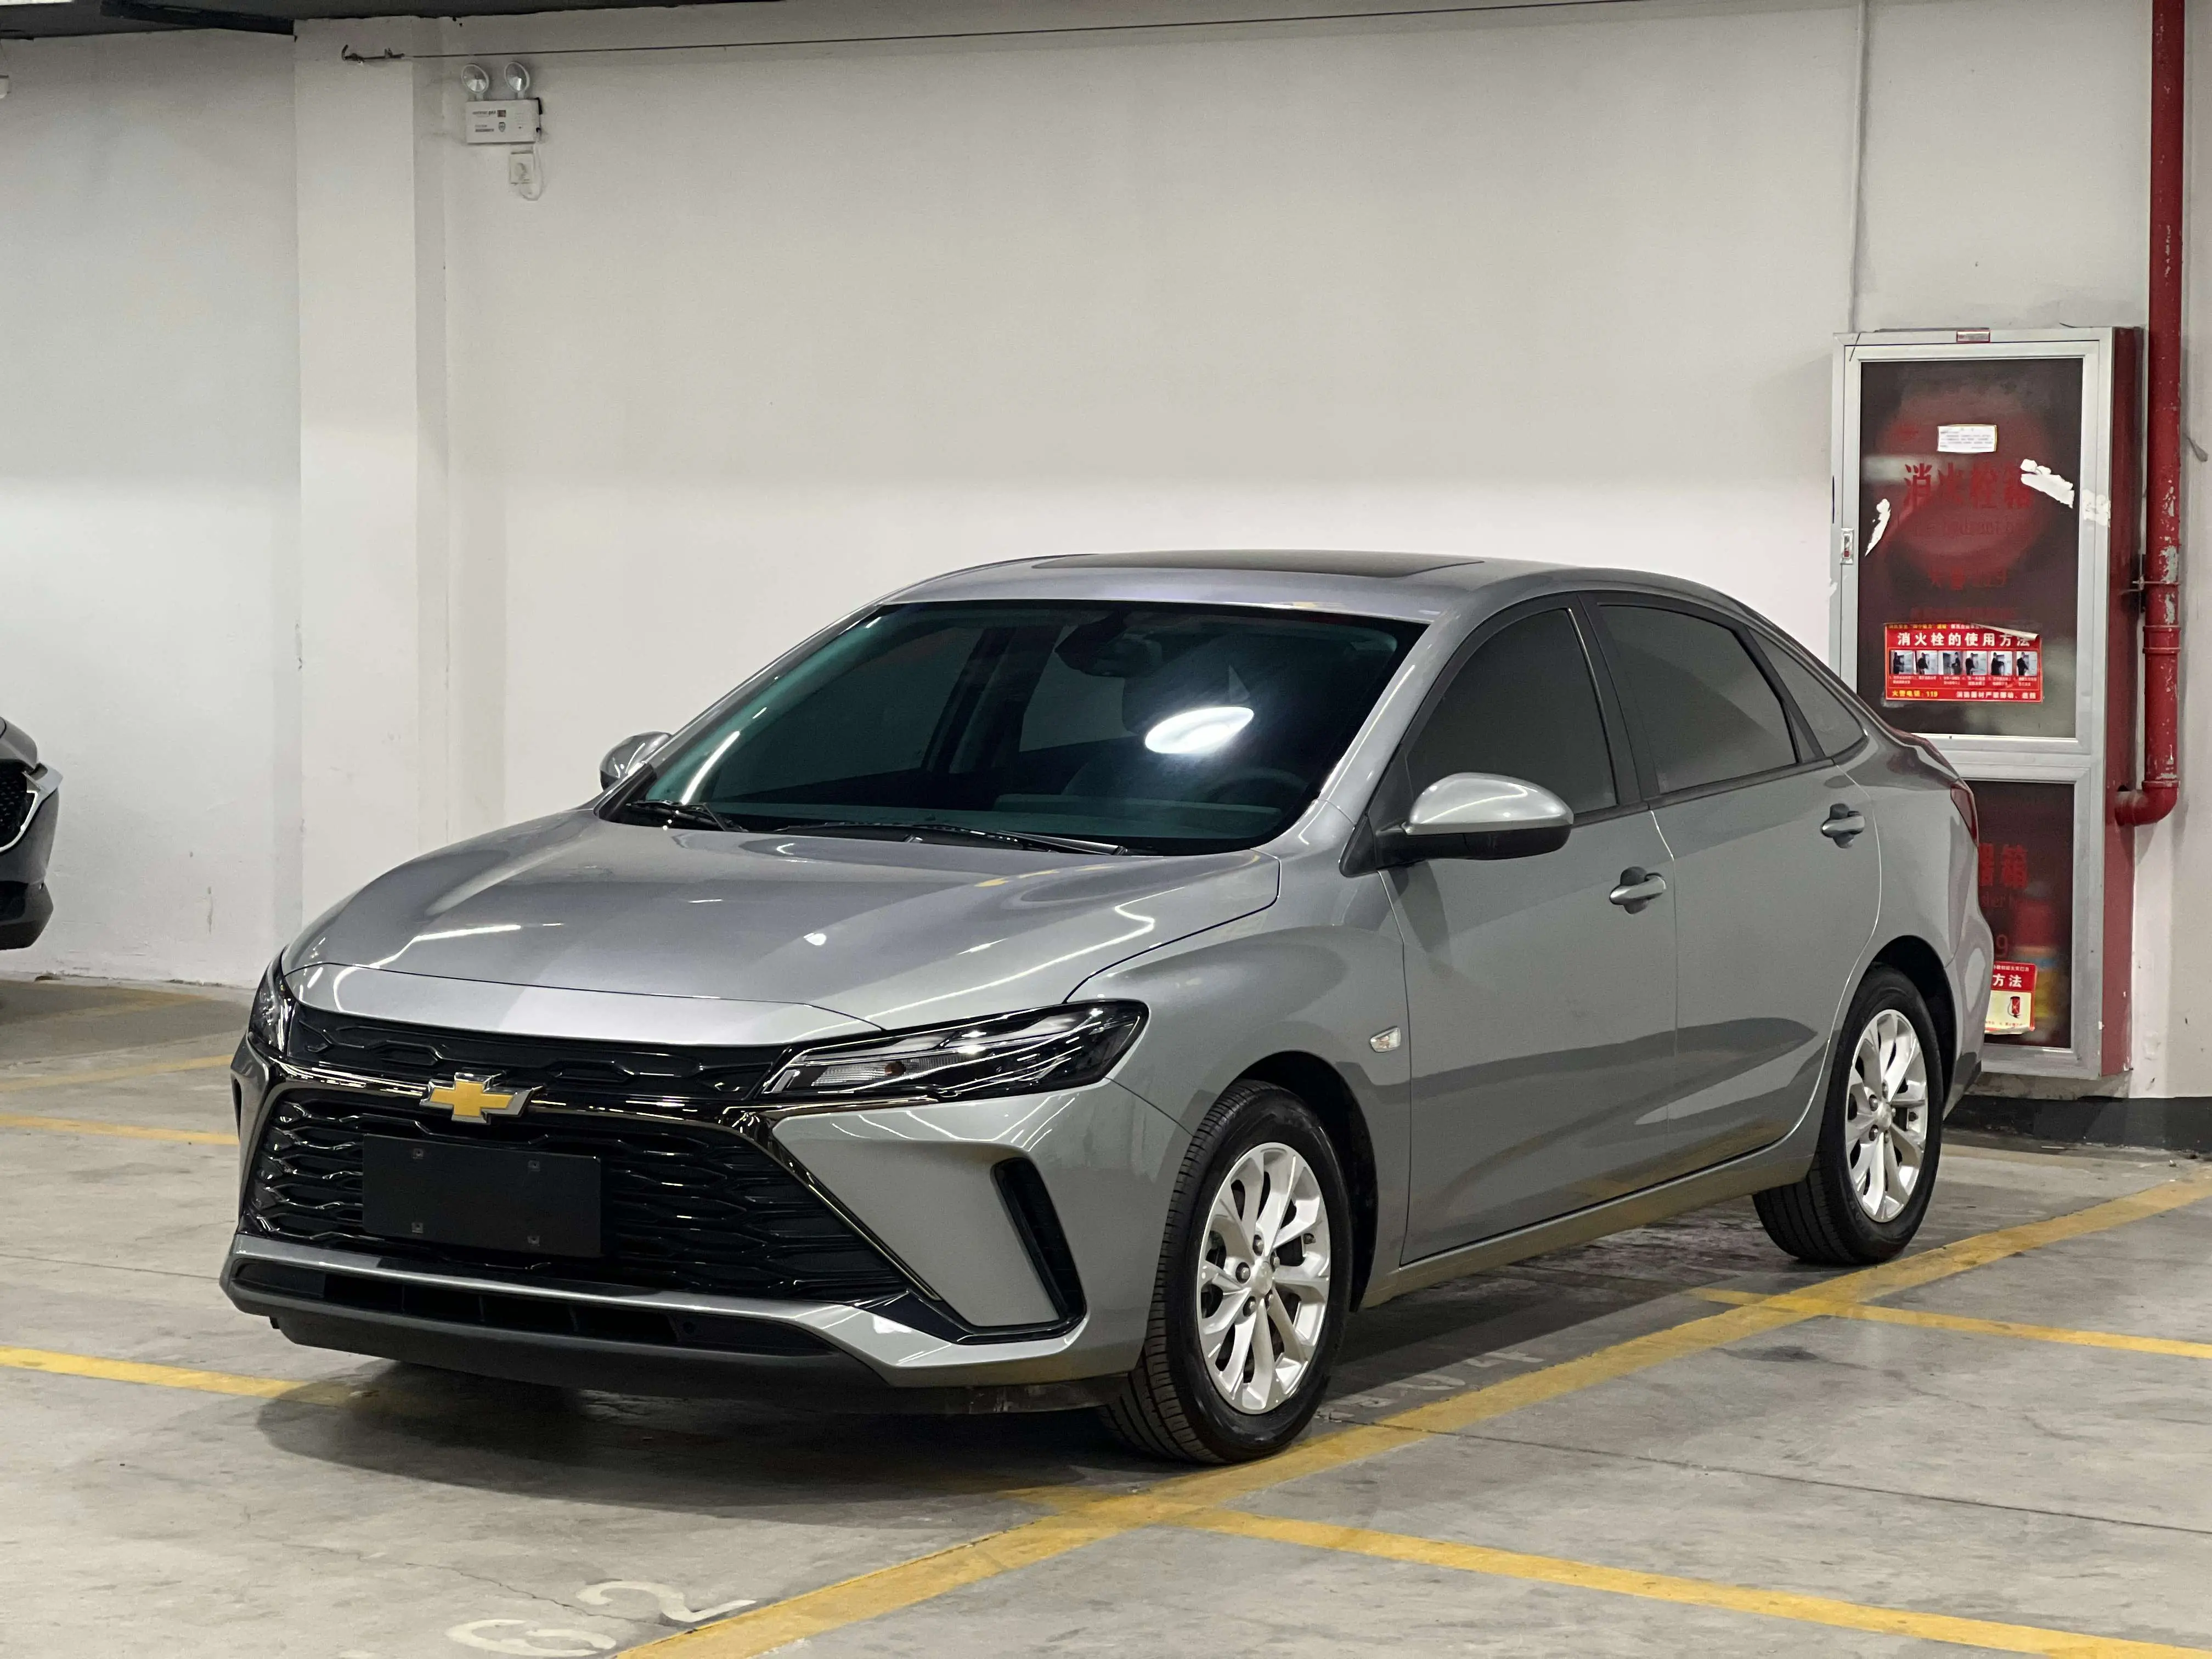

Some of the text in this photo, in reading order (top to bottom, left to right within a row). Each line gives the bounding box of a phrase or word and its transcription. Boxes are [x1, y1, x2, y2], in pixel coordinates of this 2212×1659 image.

[1897, 632, 2030, 647] 消火栓的使用方法
[1993, 973, 2022, 988] 方法
